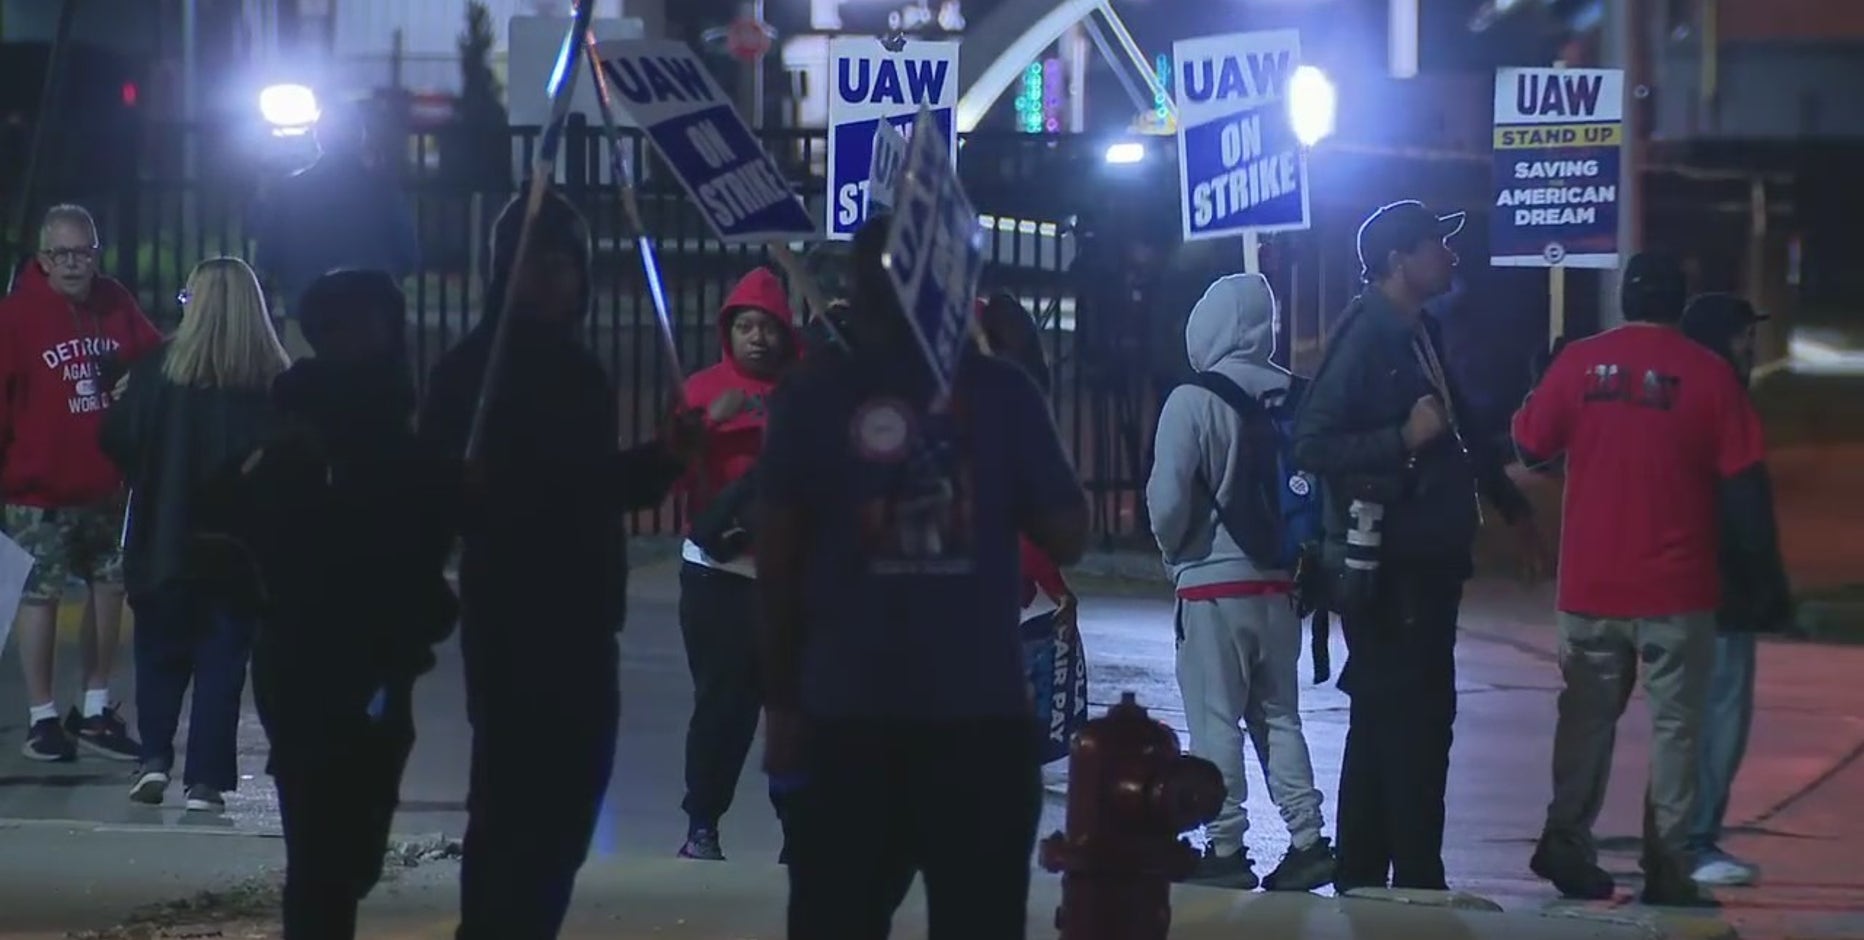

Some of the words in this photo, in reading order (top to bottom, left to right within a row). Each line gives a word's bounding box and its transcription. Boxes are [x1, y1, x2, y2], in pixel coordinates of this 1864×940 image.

[601, 56, 715, 104] UAW
[838, 57, 949, 105] UAW
[1183, 50, 1290, 104] UAW
[1516, 74, 1603, 117] UAW
[686, 118, 738, 170] ON
[1220, 114, 1262, 169] ON
[1502, 128, 1577, 146] STAND
[1584, 126, 1614, 143] UP
[699, 158, 790, 228] STRIKE
[1193, 150, 1297, 228] STRIKE
[1514, 160, 1600, 179] SAVING
[1496, 185, 1616, 206] AMERICAN
[1514, 207, 1596, 226] DREAM
[1050, 691, 1067, 742] PAY
